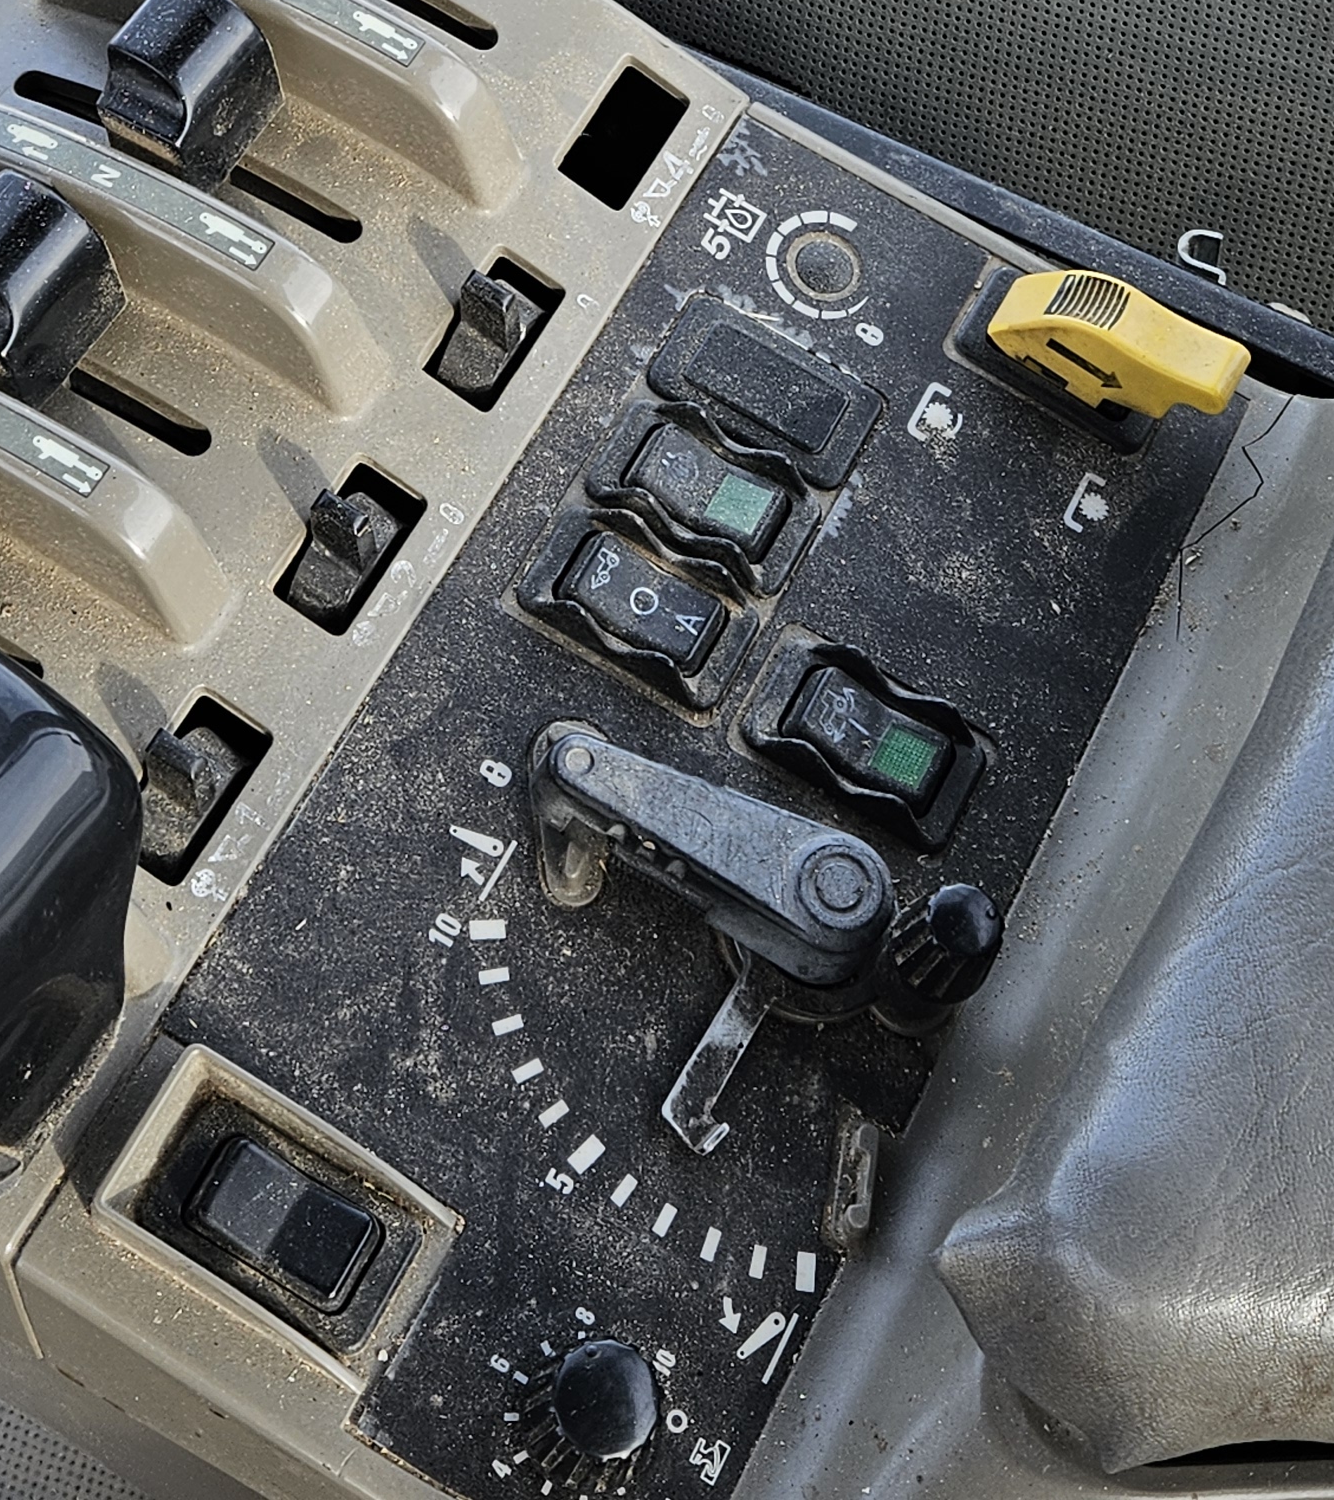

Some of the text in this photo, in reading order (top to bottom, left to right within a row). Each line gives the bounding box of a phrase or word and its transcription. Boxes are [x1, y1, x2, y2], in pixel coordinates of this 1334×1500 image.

[91, 163, 121, 188] N
[701, 228, 731, 260] 5
[675, 612, 706, 637] A
[429, 913, 462, 947] 10
[547, 1167, 575, 1195] 5
[575, 1306, 595, 1325] 8
[489, 1354, 510, 1373] 6
[652, 1348, 676, 1377] 10
[492, 1459, 512, 1478] 4
